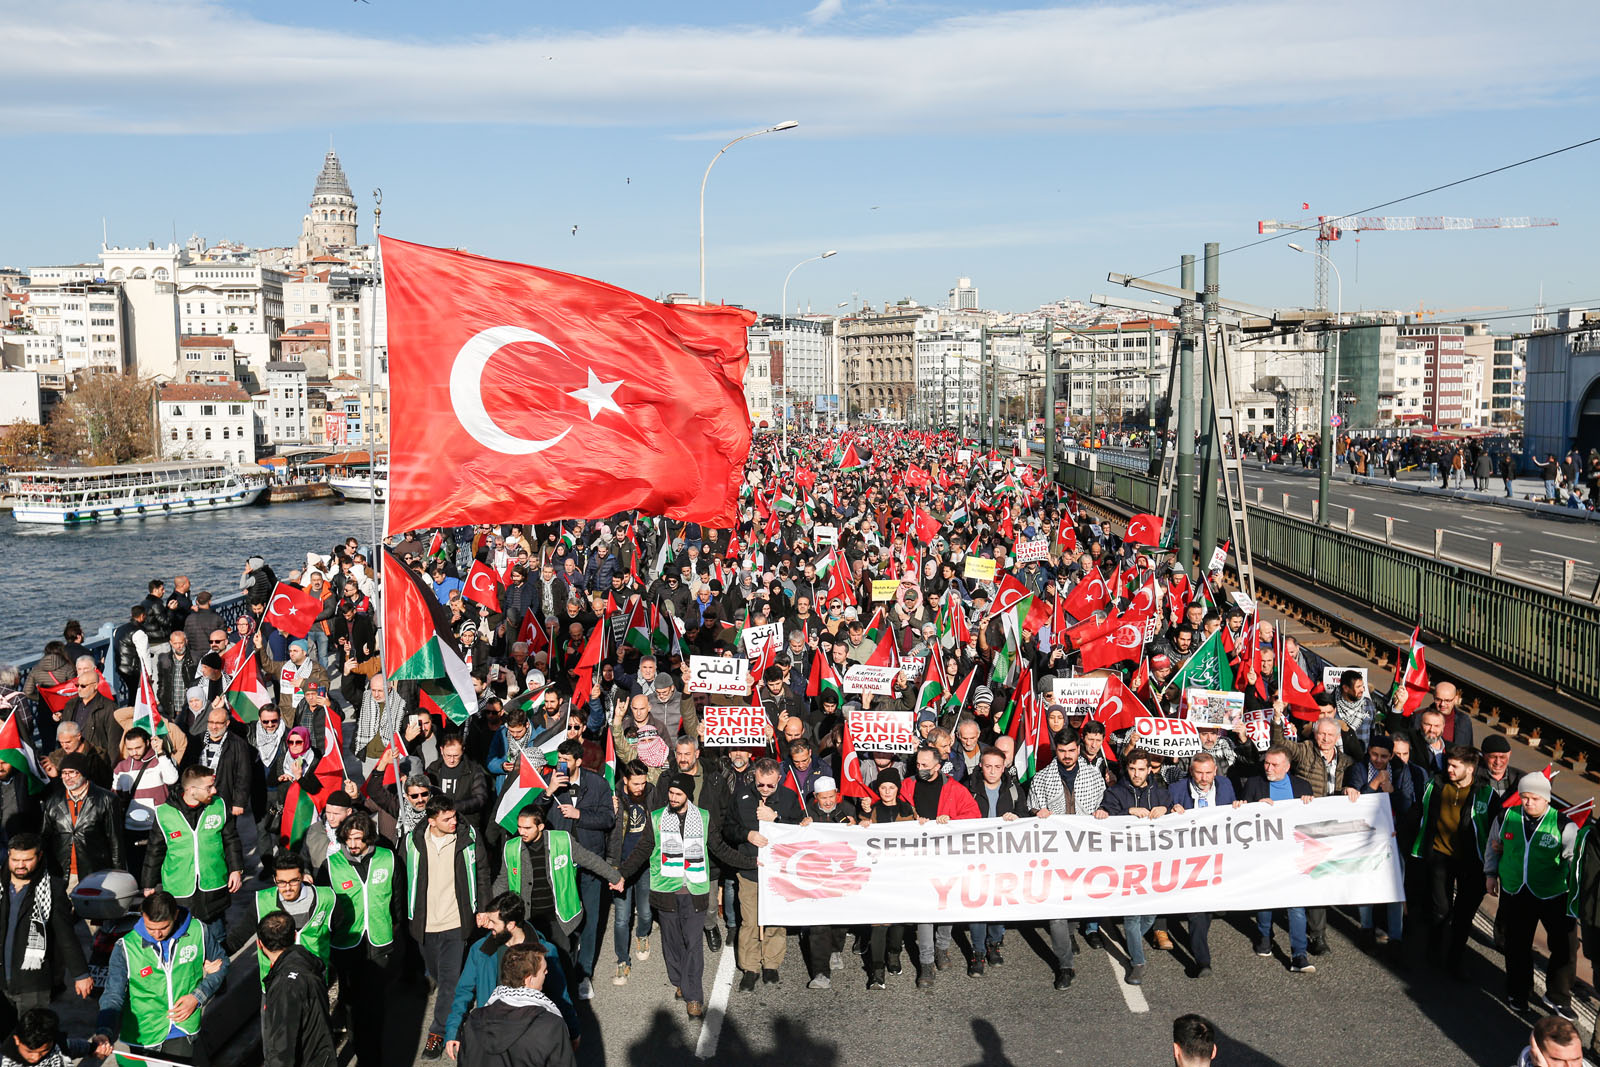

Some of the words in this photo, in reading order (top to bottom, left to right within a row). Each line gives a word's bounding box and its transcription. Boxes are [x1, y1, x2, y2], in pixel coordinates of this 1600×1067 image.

[1017, 540, 1047, 549] REFAH
[1017, 546, 1048, 555] SINIR
[697, 659, 740, 680] إفتح
[901, 664, 924, 672] AFAH
[845, 675, 890, 683] MÜSLÜMANLAR
[690, 680, 712, 691] رفح
[716, 684, 746, 692] معبر
[1090, 689, 1101, 697] AÇ
[705, 707, 764, 716] REFAH
[1244, 709, 1273, 722] REF
[705, 716, 765, 727] SINIR
[1137, 718, 1197, 735] OPEN
[706, 727, 765, 736] KAPISI
[706, 736, 765, 745] AÇILSIN!
[851, 734, 912, 743] KAPISI
[1139, 737, 1160, 746] THE
[1163, 737, 1200, 747] RAFAH
[853, 742, 912, 751] AÇILSIN!
[866, 823, 1059, 864] ŞEHİTLERİMİZ
[1065, 830, 1102, 852] VE
[1110, 819, 1218, 852] FİLİSTİN
[1225, 813, 1284, 849] İÇİN
[930, 853, 1224, 910] YÜRÜYORUZ!
